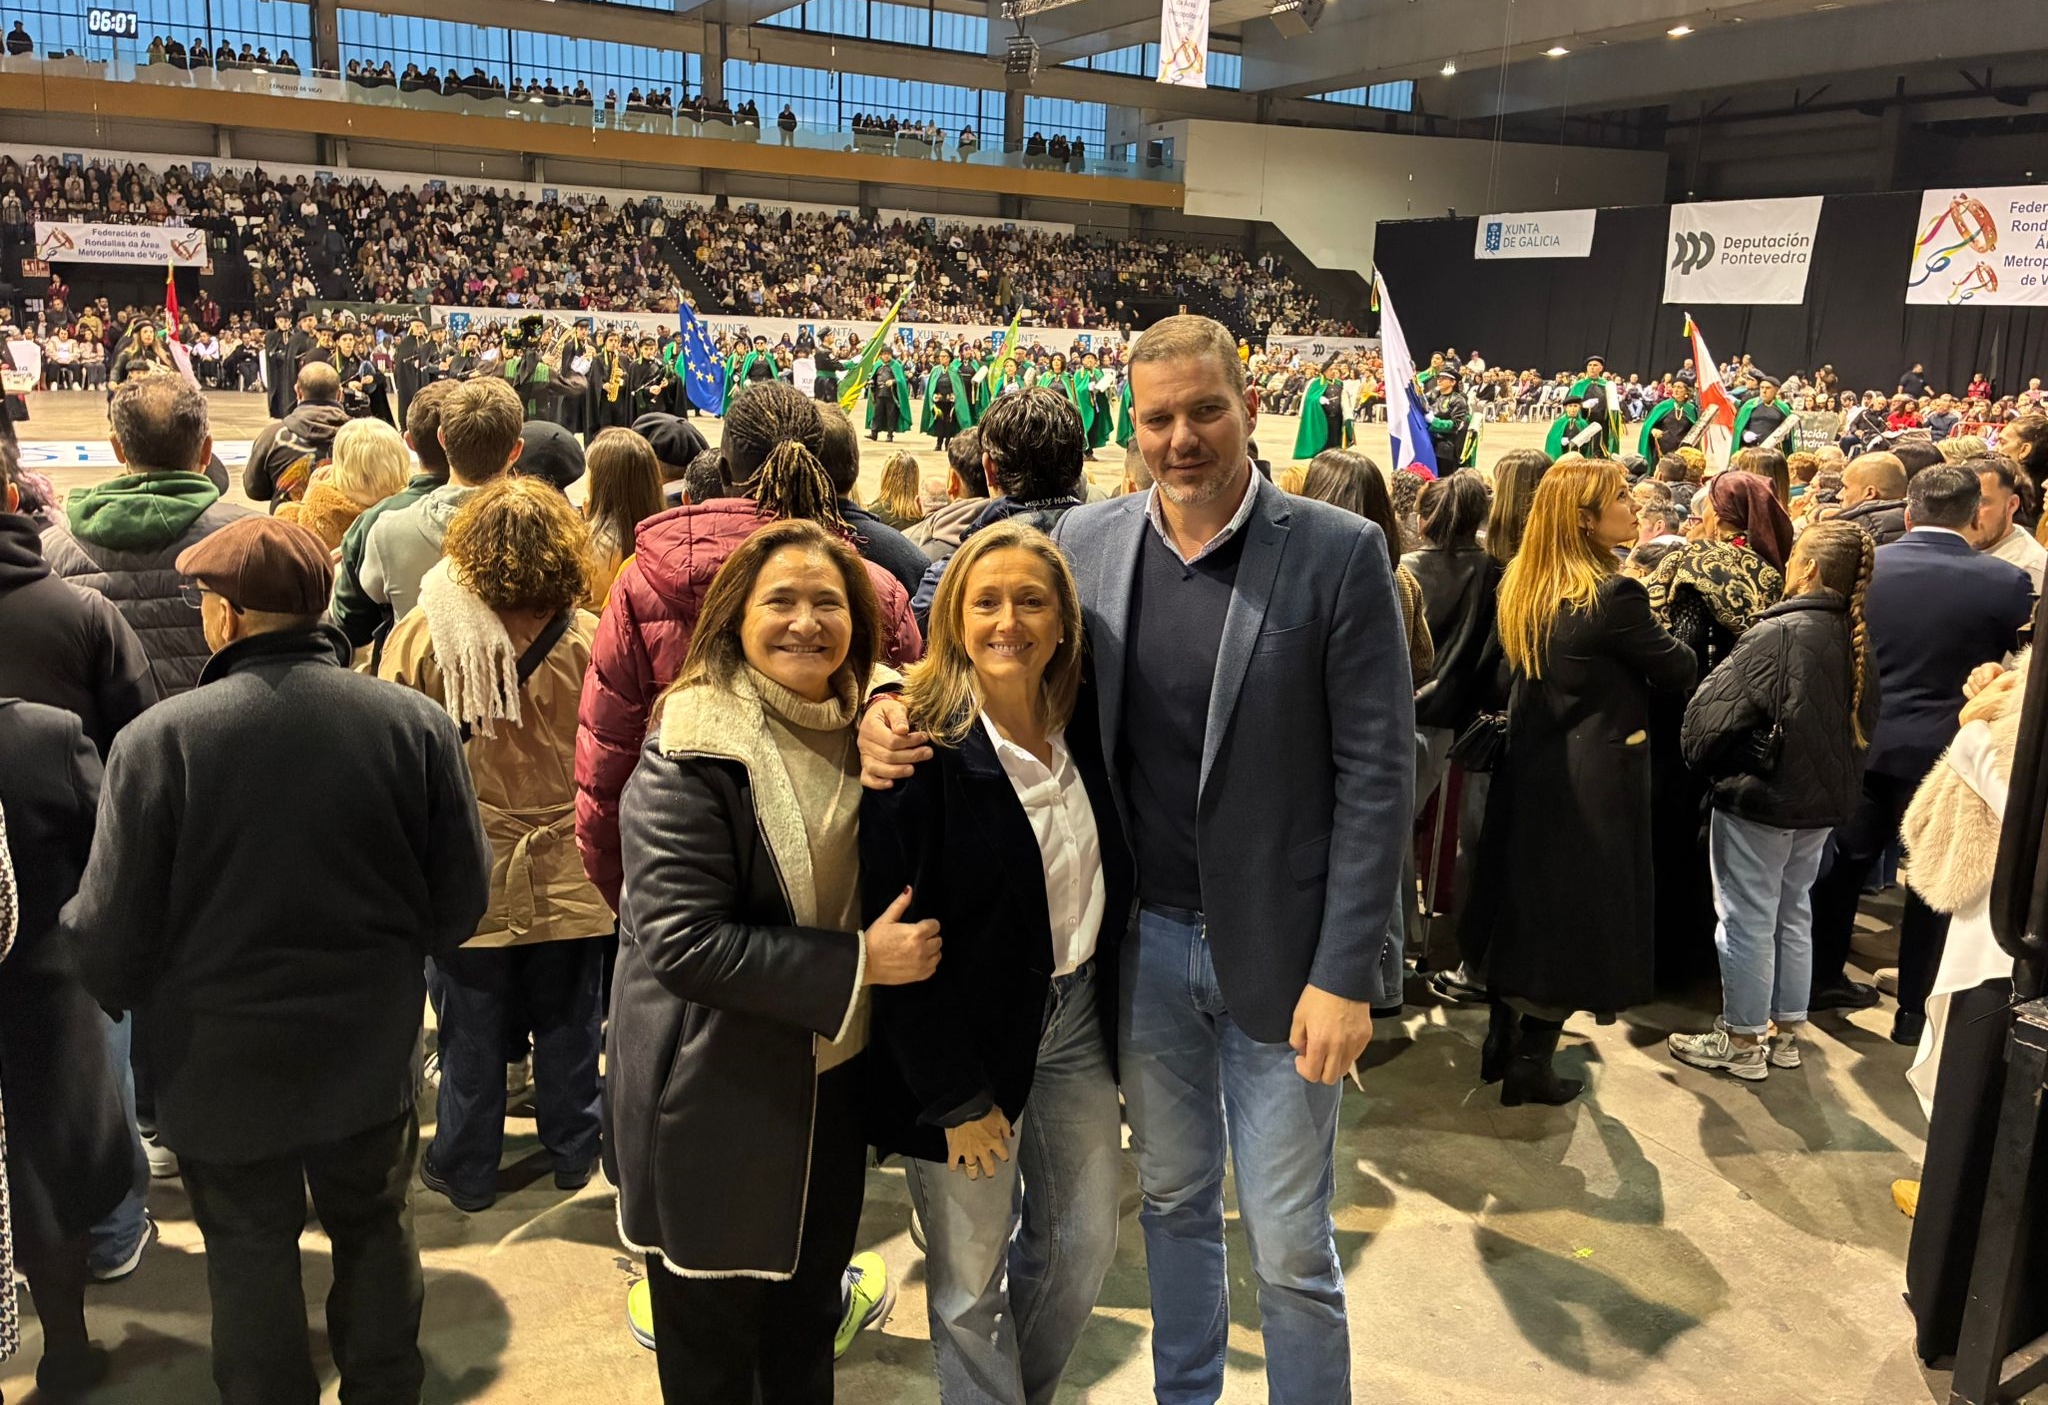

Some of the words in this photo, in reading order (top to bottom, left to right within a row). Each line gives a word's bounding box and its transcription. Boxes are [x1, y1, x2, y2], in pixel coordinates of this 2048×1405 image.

[89, 10, 137, 34] 06:07
[1504, 223, 1540, 236] XUNTA
[2011, 219, 2048, 232] Rond
[92, 228, 139, 238] Federación
[140, 228, 151, 239] de
[84, 239, 126, 248] Rondallas
[128, 241, 139, 249] da
[140, 239, 160, 249] Área
[1503, 237, 1517, 248] DE
[1518, 235, 1561, 248] GALICIA
[1723, 232, 1810, 253] Deputación
[78, 248, 135, 260] Metropolitana
[136, 250, 148, 259] de
[149, 250, 169, 261] Vigo
[1720, 251, 1808, 266] Pontevedra
[2020, 275, 2037, 286] de
